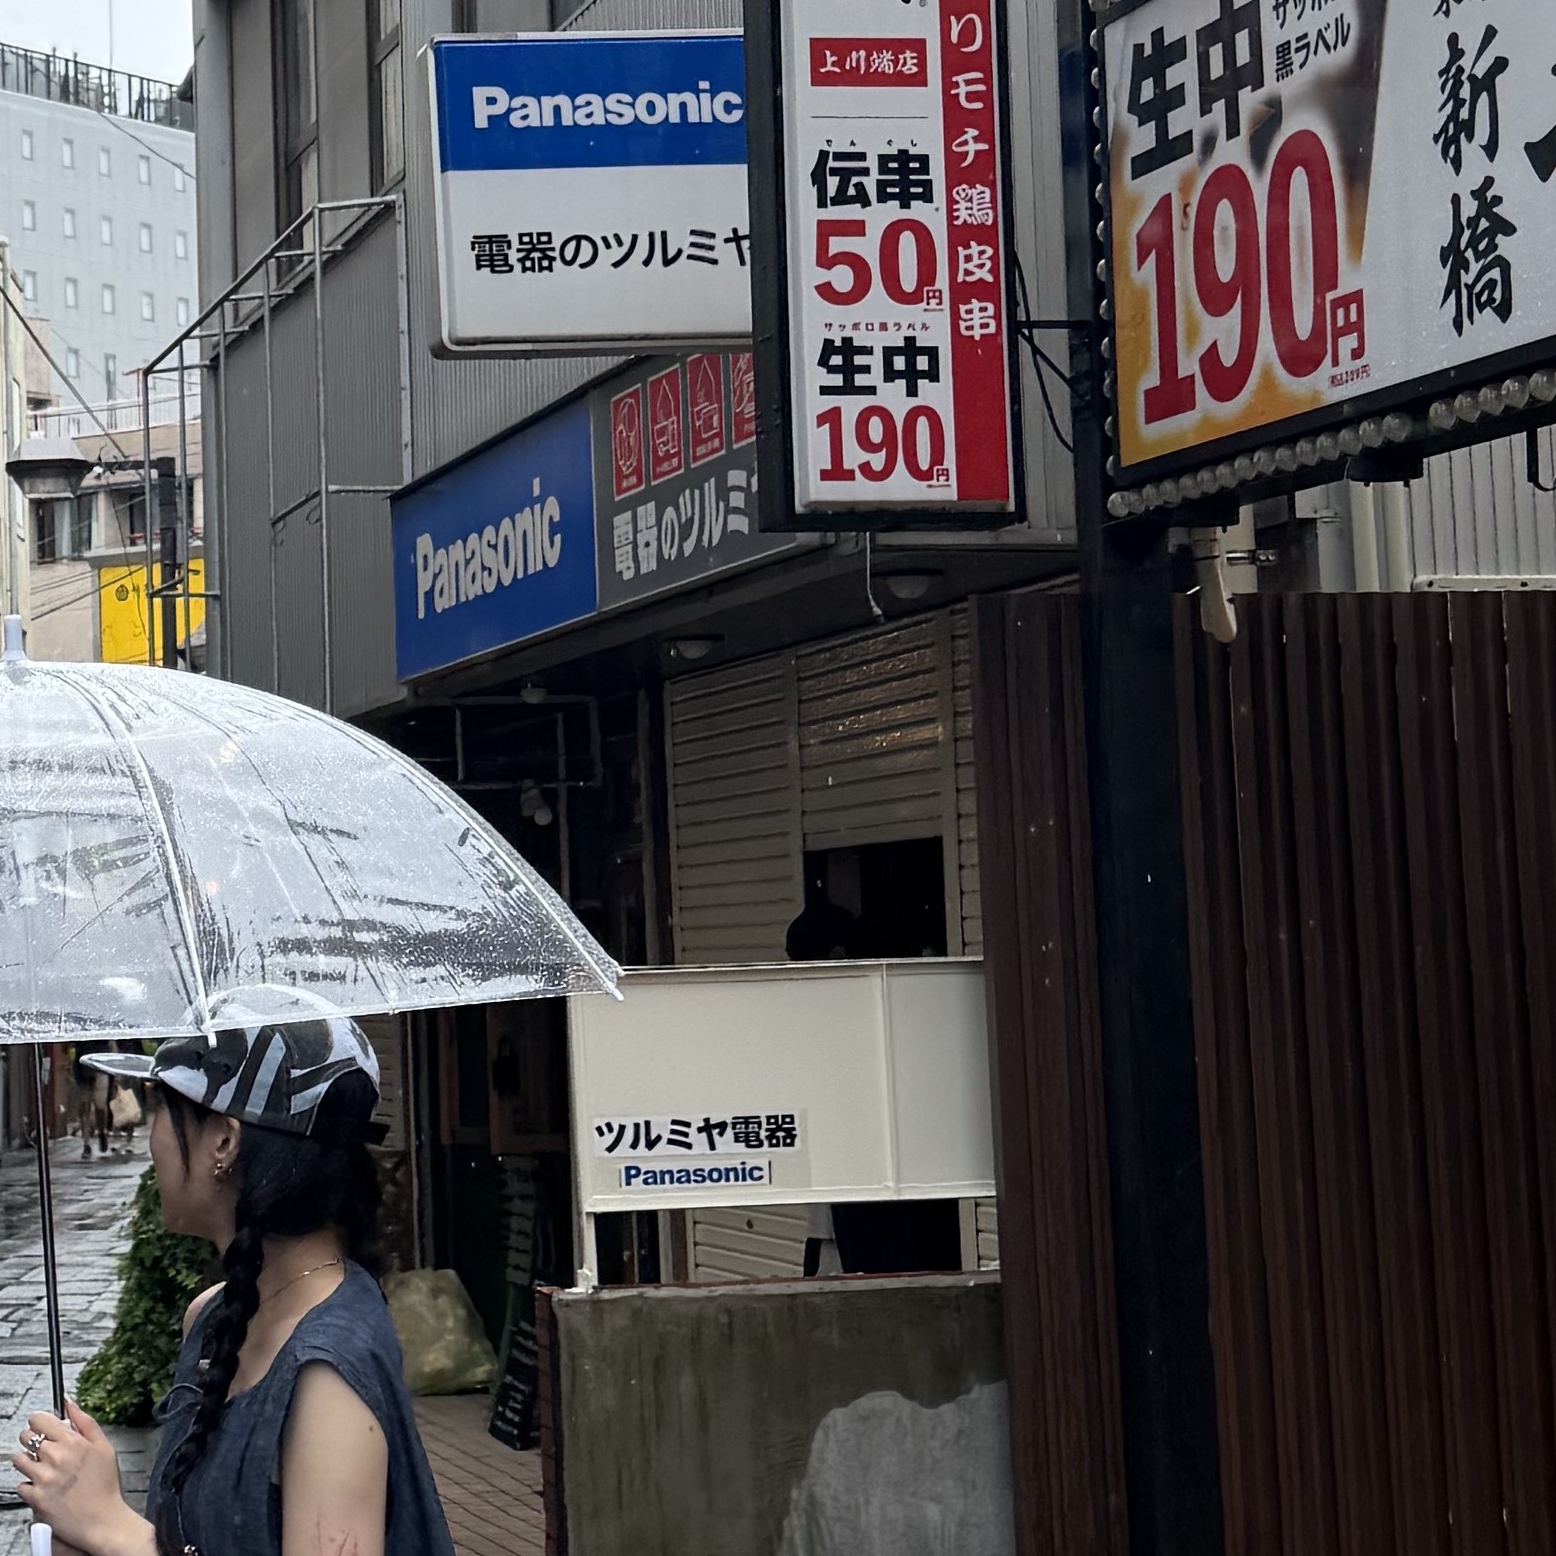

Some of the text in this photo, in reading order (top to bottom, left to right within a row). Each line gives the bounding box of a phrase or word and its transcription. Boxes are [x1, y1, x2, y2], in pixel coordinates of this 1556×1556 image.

[1272, 0, 1334, 29] サッ
[819, 49, 919, 75] 上川端店
[1275, 13, 1351, 82] 黒ラベル
[472, 80, 744, 129] Panasonic
[1127, 0, 1265, 181] 生中
[810, 149, 934, 209] 伝串
[1433, 0, 1517, 338] 新橋
[817, 335, 940, 398] 生中
[416, 477, 562, 620] Panasonic
[612, 469, 758, 581] 電器のツルミ
[595, 1114, 798, 1154] ツルミヤ電器
[624, 1160, 764, 1187] Panasonic
